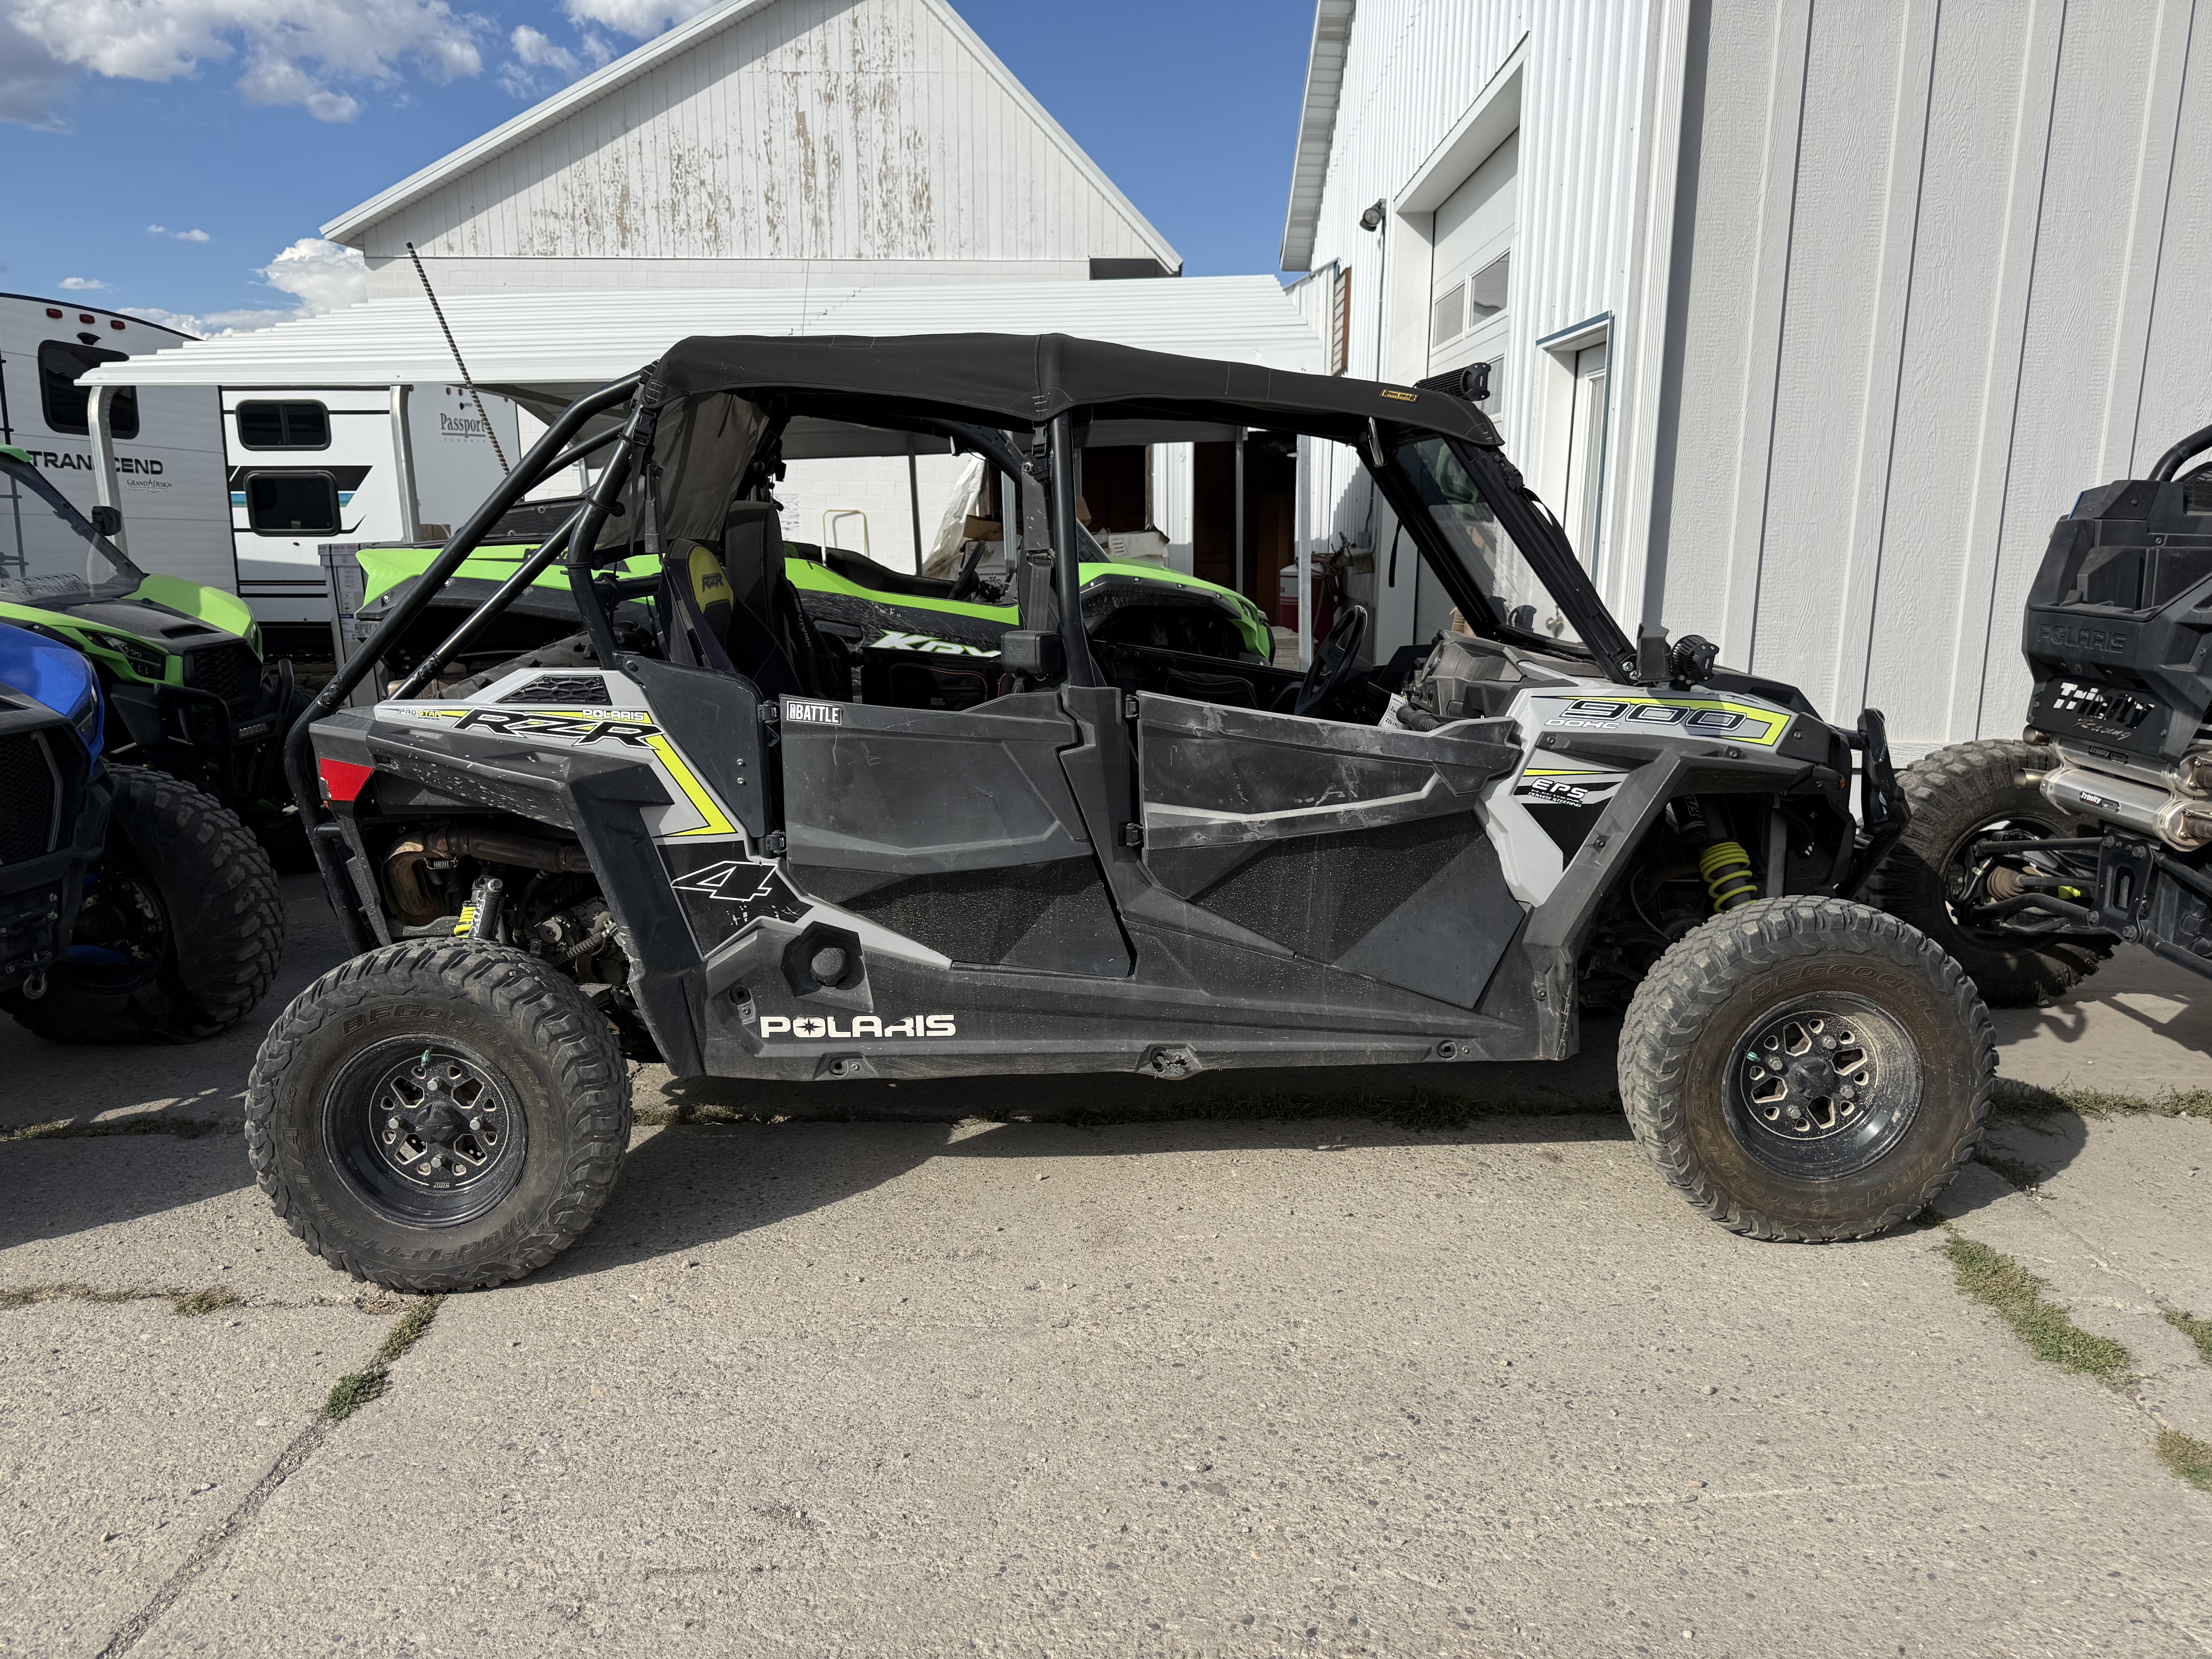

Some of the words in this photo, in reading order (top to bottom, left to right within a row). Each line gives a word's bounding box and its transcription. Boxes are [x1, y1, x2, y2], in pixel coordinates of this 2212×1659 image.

[440, 413, 485, 438] Passport
[26, 450, 163, 475] TRANEND
[127, 479, 148, 487] GRAND
[153, 480, 173, 488] DESIGN
[702, 572, 723, 593] RZR
[2037, 623, 2127, 654] POLARIS
[582, 708, 645, 721] POLARIS
[796, 704, 840, 723] BATTLE
[1558, 698, 1747, 731] 900
[2053, 682, 2155, 729] Trinity
[451, 707, 666, 750] RZR
[1544, 719, 1621, 730] DOHC
[2089, 746, 2111, 757] Trinity
[1527, 792, 1552, 800] POWER
[1552, 797, 1582, 808] STEERING
[1532, 778, 1589, 799] EPS
[2080, 792, 2102, 804] Trinity
[670, 860, 778, 902] 4
[1750, 962, 1957, 1047] BFGoodrich
[759, 1015, 956, 1038] POLARIS
[342, 1004, 550, 1108] BFGoodrich
[1692, 1098, 1721, 1157] T/A
[282, 1128, 313, 1189] T/A
[1718, 1148, 1933, 1214] Mud-Terrain
[308, 1194, 526, 1264] Mud-Terrain
